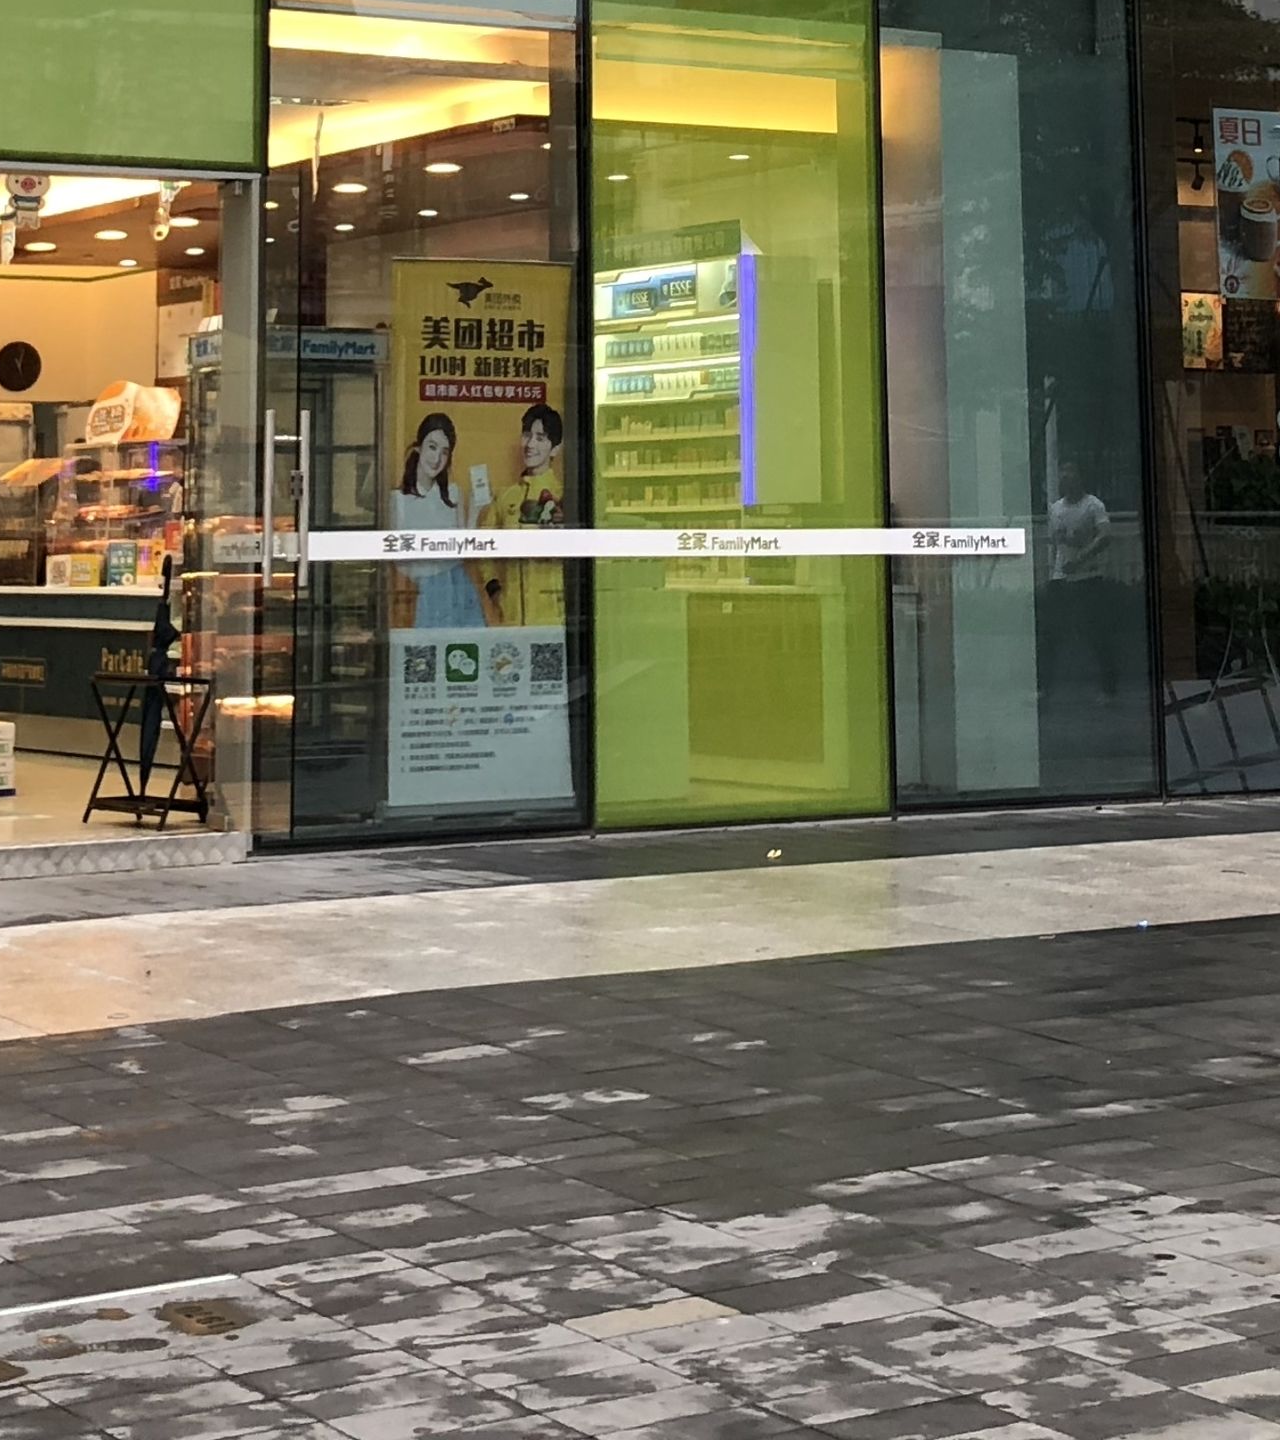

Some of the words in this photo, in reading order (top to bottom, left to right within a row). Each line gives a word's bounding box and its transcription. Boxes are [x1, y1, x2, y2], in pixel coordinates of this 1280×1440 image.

[1218, 117, 1262, 146] 夏日
[632, 290, 649, 305] ESSE
[670, 280, 693, 296] ESSE
[421, 316, 545, 352] 美团超市
[303, 339, 376, 357] FamilyMart
[419, 356, 466, 377] 1小时
[474, 357, 549, 379] 新鲜到家
[425, 384, 542, 399] 超市新人红包专享15元
[382, 532, 416, 553] 全家
[420, 535, 495, 555] FamilyMart
[677, 532, 707, 551] 全家
[711, 534, 780, 554] FamilyMart
[912, 531, 940, 549] 全家
[943, 533, 1006, 551] FamilyMart
